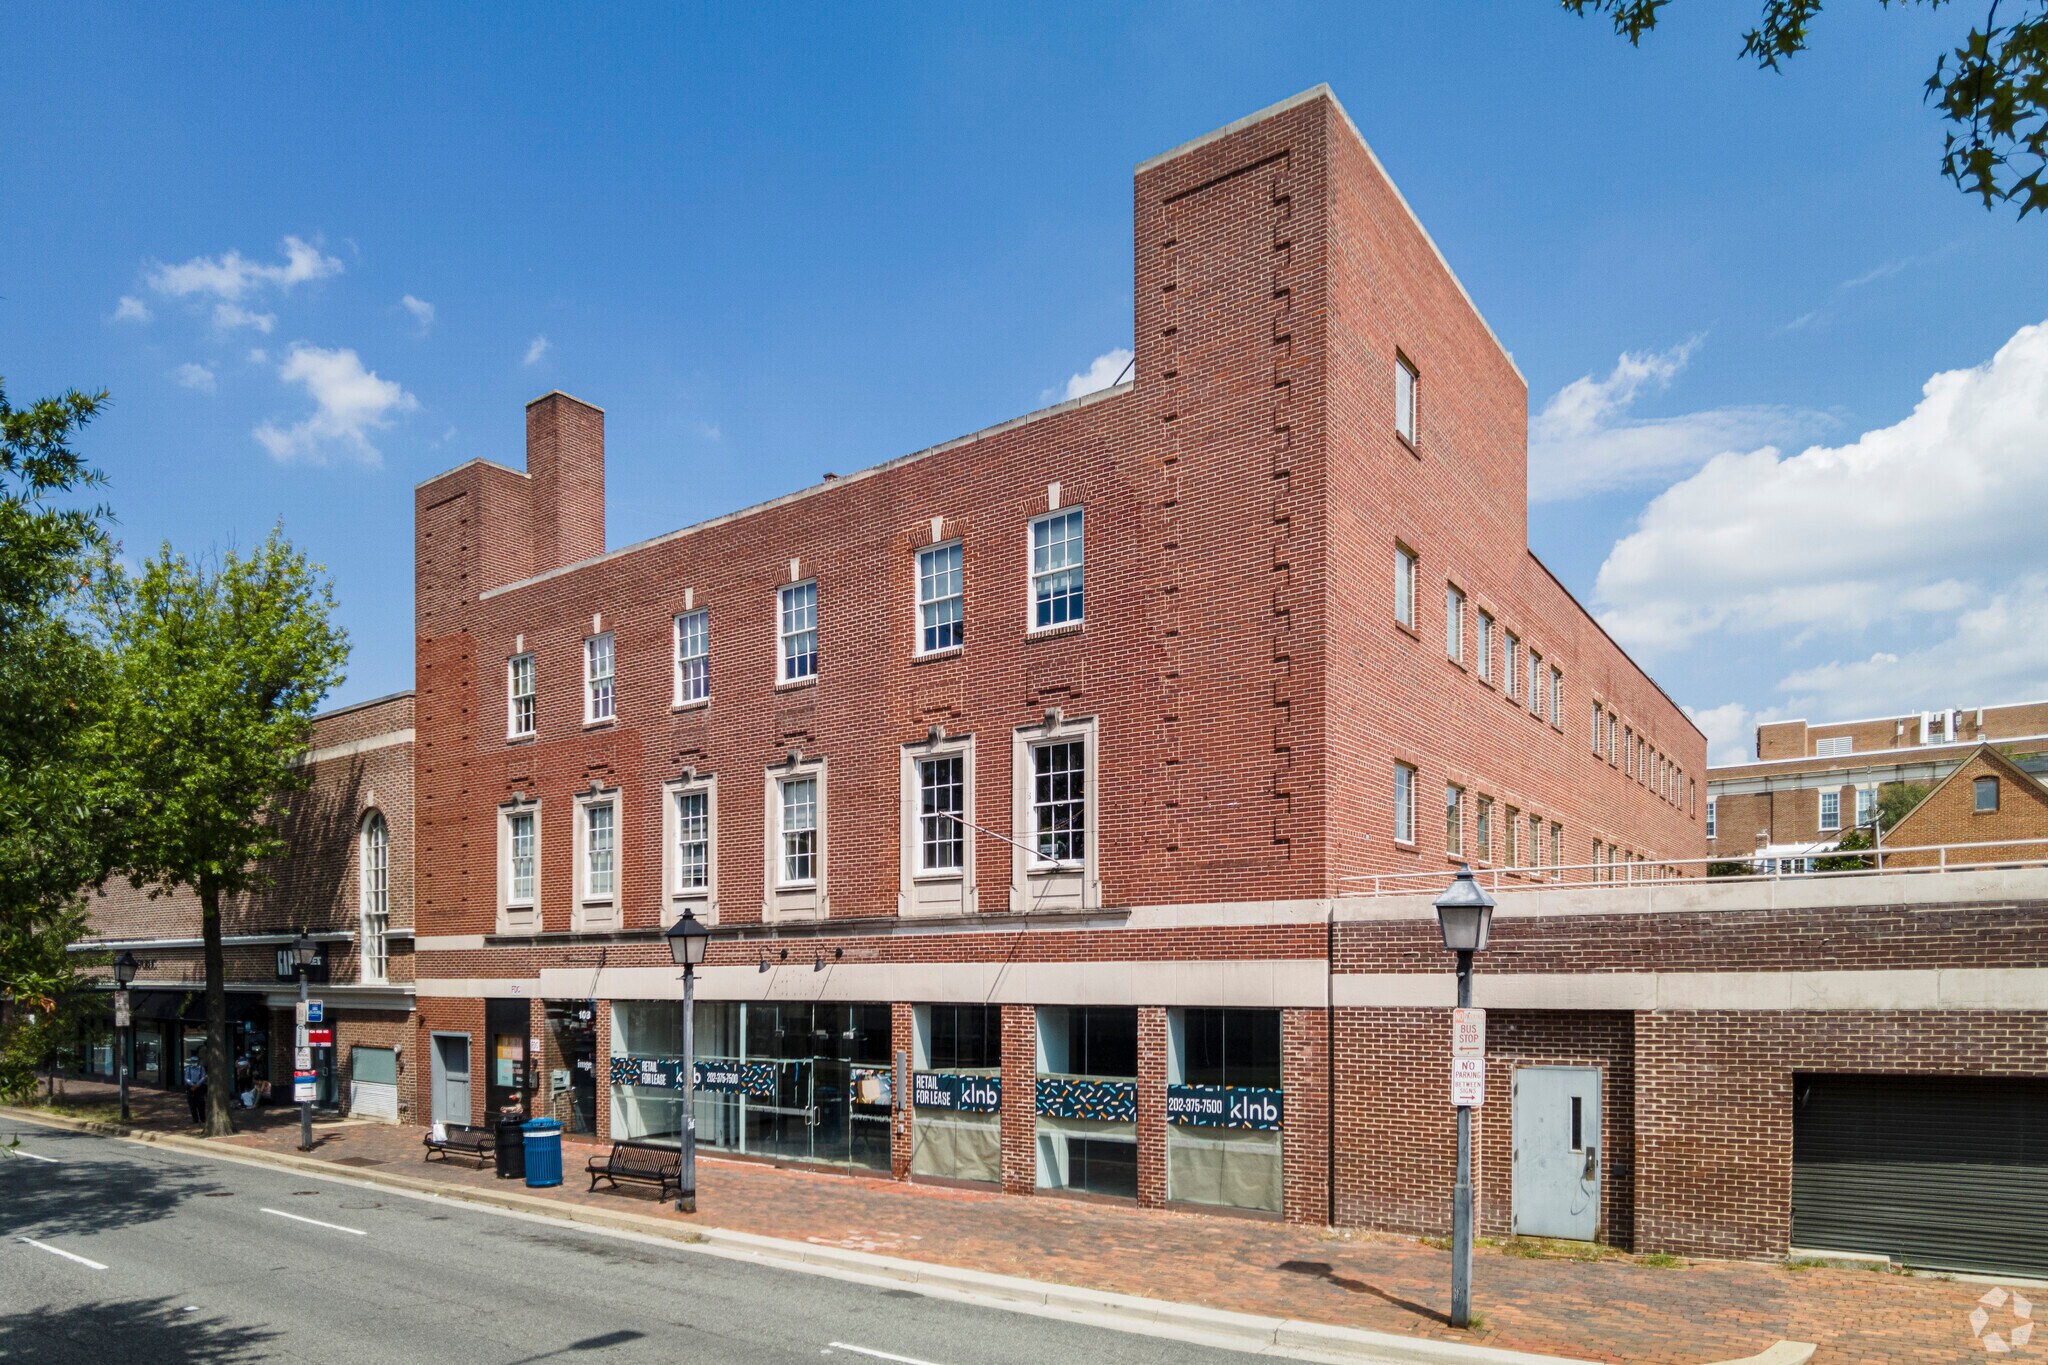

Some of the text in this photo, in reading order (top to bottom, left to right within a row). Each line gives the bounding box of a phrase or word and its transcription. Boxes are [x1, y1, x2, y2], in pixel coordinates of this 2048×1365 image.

[578, 1010, 592, 1020] 103
[1460, 1024, 1477, 1034] BUS
[1459, 1034, 1479, 1043] STOP
[641, 1060, 658, 1073] RETAIL
[1461, 1061, 1475, 1071] NO
[641, 1073, 667, 1086] FOR LEASE
[706, 1072, 739, 1084] 202-375-7500
[1455, 1071, 1481, 1079] PARKING
[916, 1074, 939, 1090] RETAIL
[916, 1089, 951, 1106] FOR LEASE
[961, 1082, 998, 1105] klnb
[1168, 1097, 1223, 1114] 202-375-7500
[1230, 1095, 1278, 1121] klnb
